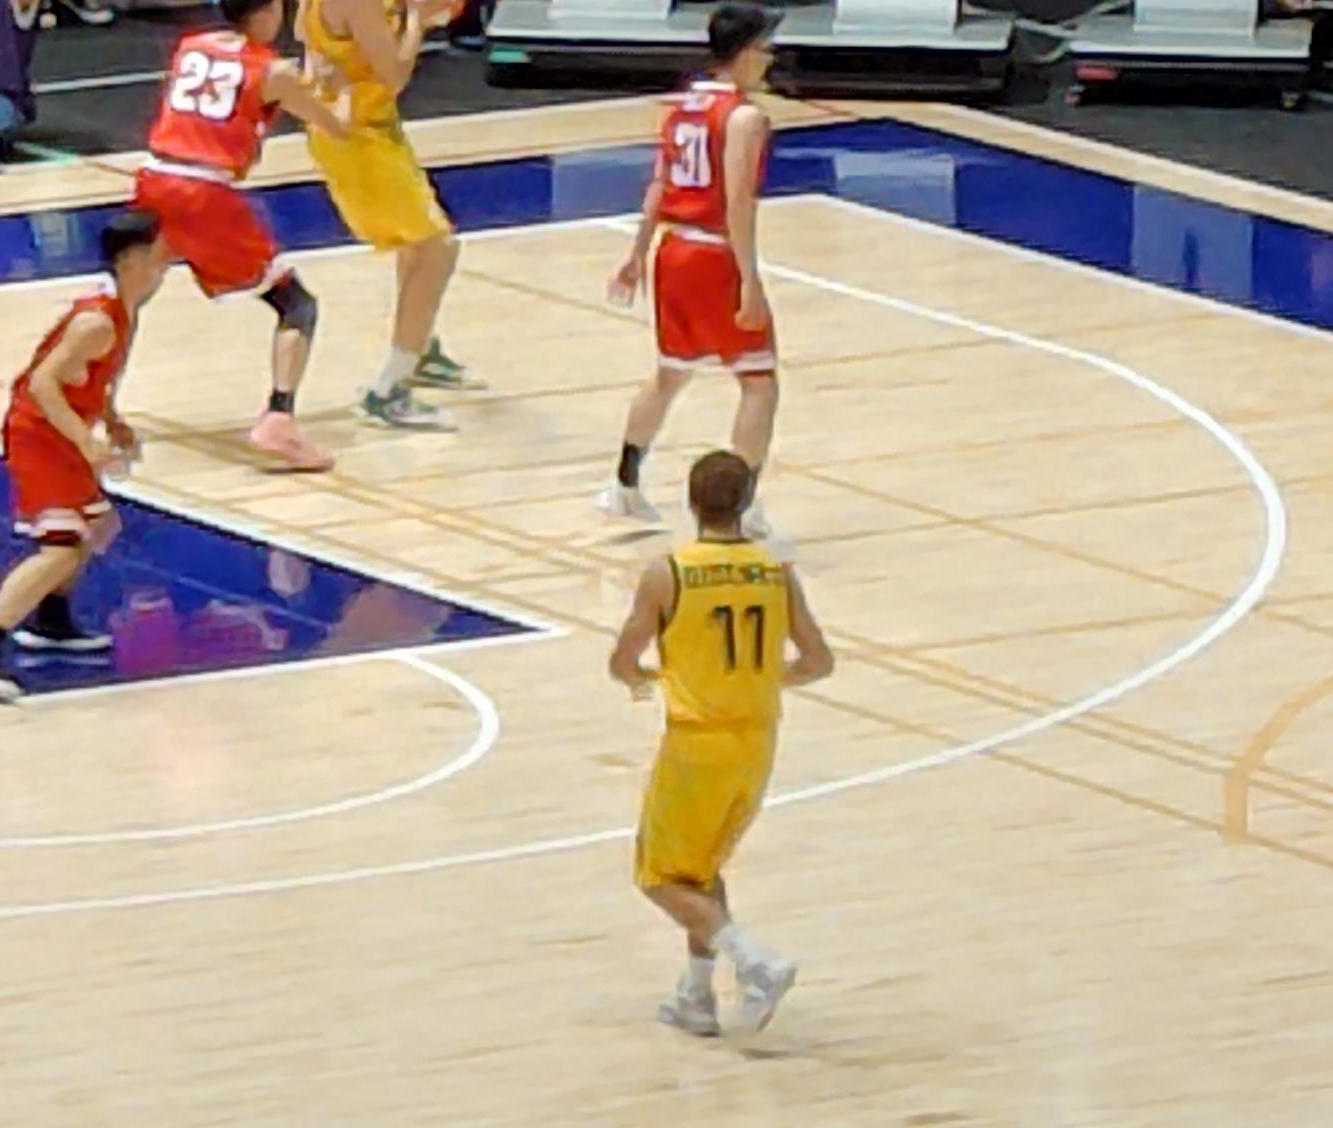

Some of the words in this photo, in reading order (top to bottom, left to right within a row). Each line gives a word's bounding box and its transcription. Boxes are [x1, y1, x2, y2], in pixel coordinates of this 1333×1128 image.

[169, 51, 244, 120] 23
[670, 121, 712, 188] 31
[710, 603, 766, 675] 11
